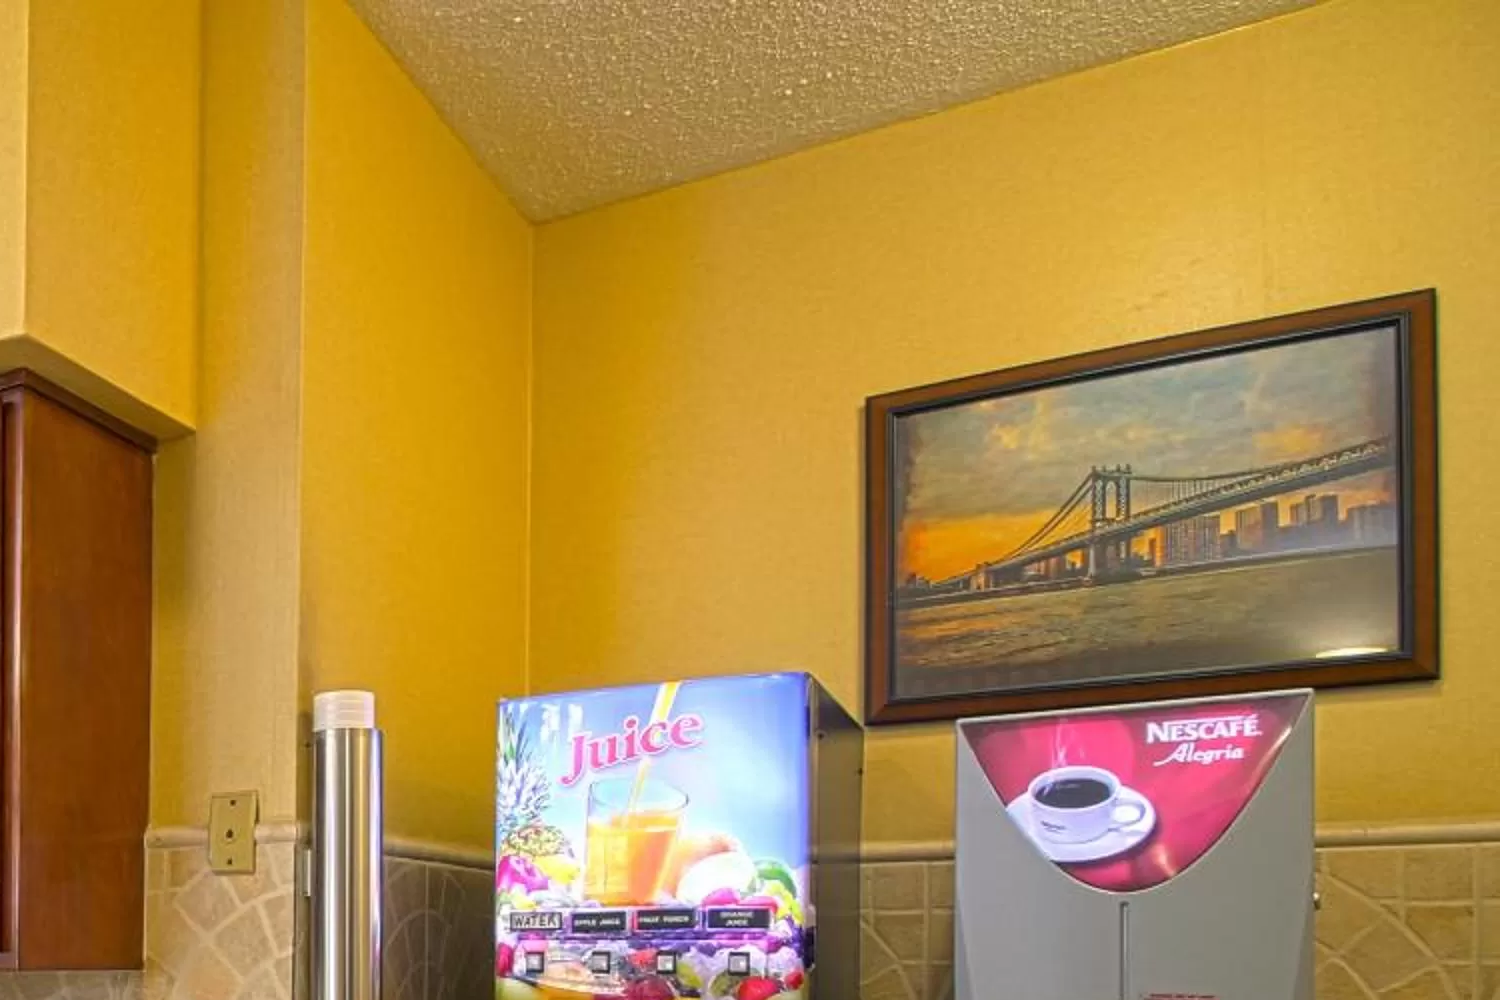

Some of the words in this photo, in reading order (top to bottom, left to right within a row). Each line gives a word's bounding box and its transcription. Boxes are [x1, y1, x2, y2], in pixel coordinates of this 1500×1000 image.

[1146, 713, 1261, 744] NESCAFÉ
[560, 713, 702, 785] Juice
[1152, 742, 1244, 767] Alegria
